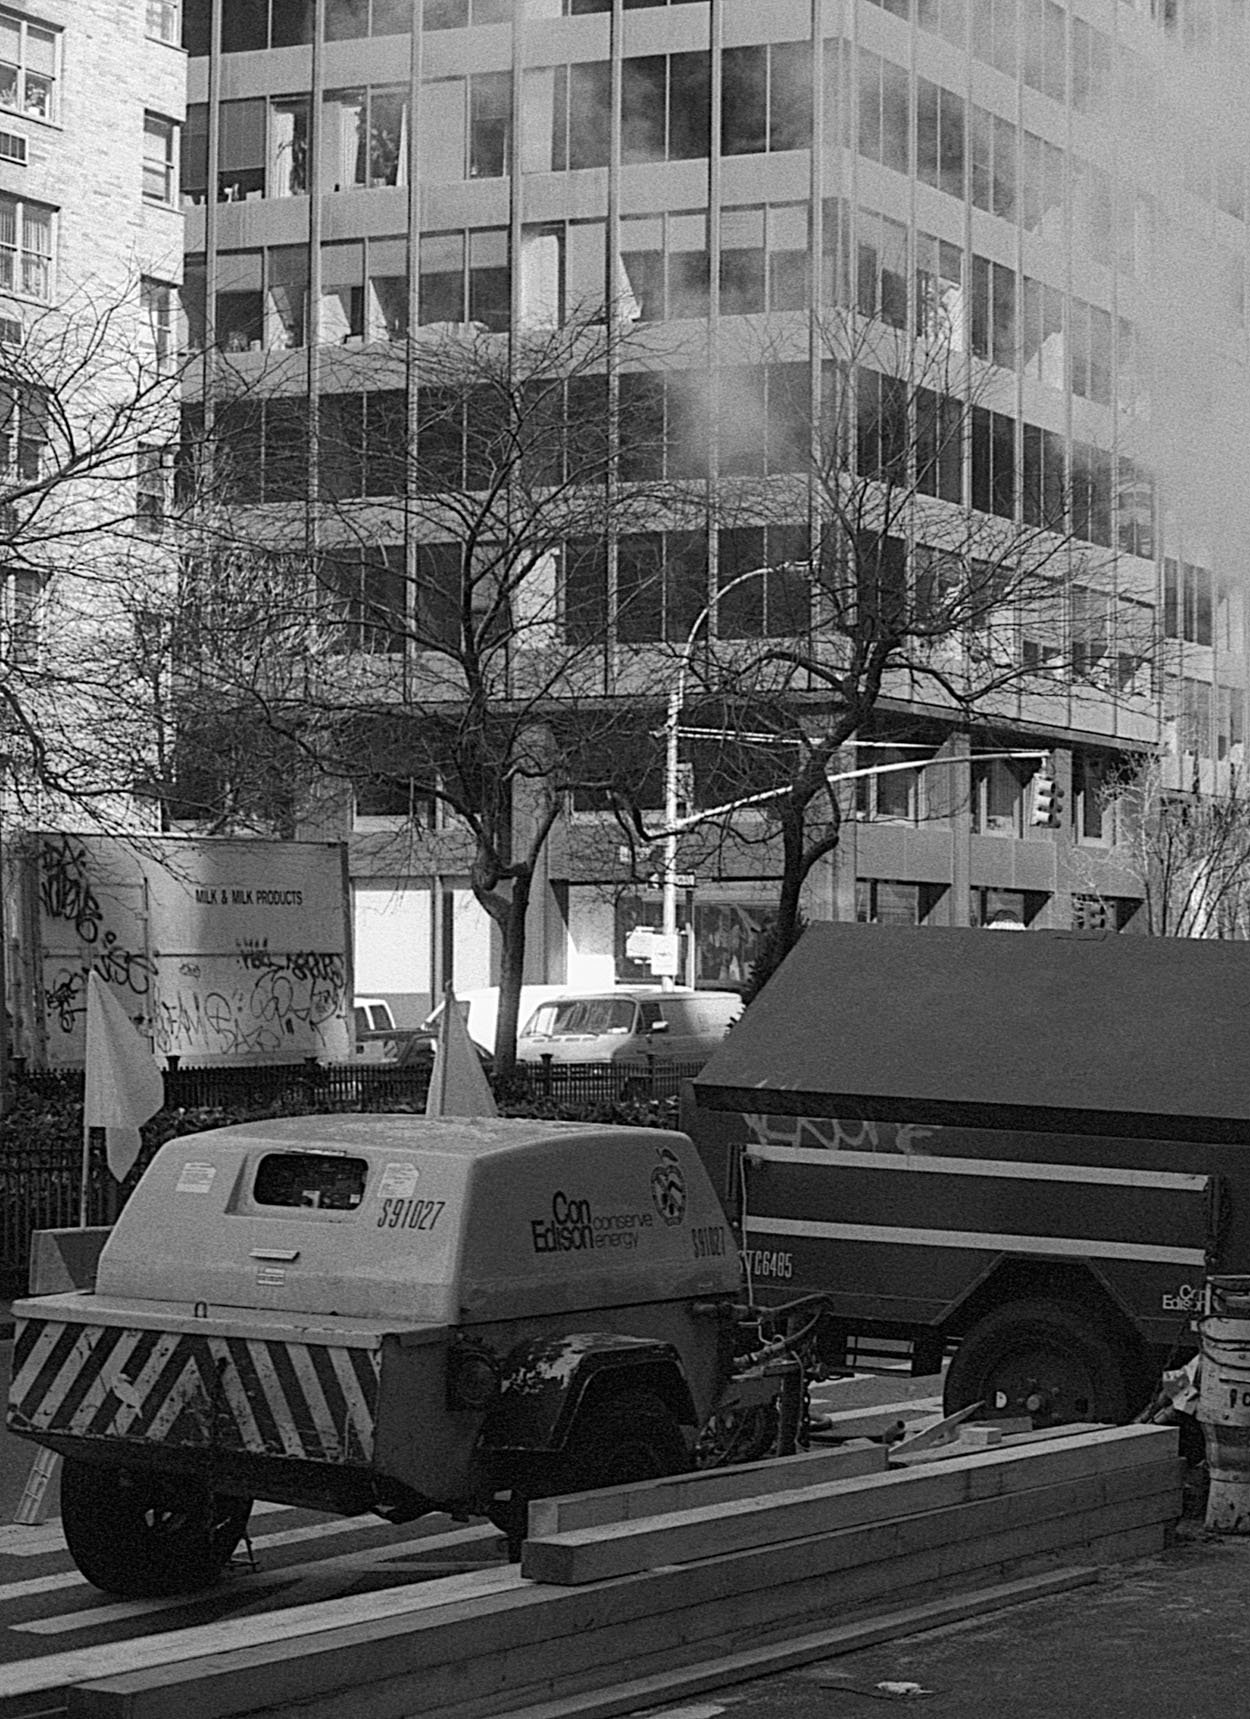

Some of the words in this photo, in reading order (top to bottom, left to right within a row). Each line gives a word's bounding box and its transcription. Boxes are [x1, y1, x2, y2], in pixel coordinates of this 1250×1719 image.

[195, 889, 218, 905] MILK
[221, 889, 229, 905] &
[231, 889, 254, 905] MILK
[255, 890, 303, 906] PRODUCTS
[377, 1199, 446, 1231] S91027
[552, 1190, 592, 1227] Con
[593, 1213, 653, 1231] conserve
[531, 1219, 594, 1253] Edison
[595, 1231, 639, 1250] energy
